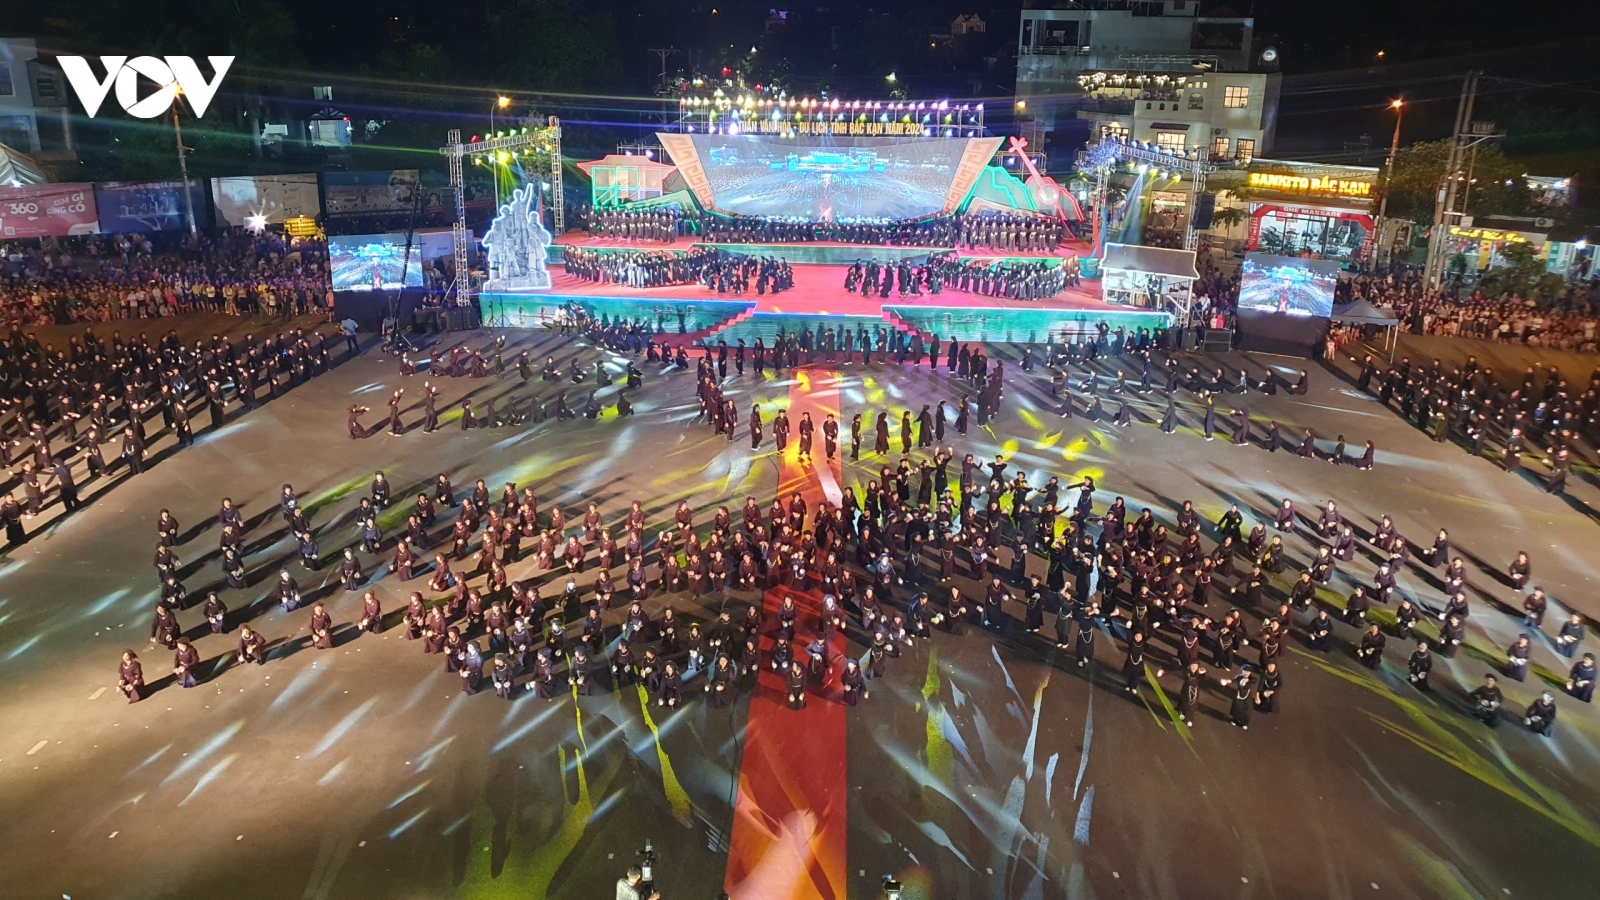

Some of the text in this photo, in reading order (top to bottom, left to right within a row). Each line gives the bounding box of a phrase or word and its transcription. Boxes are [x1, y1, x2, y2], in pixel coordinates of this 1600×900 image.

[800, 122, 809, 133] DU
[812, 122, 828, 135] LỊCH
[867, 123, 883, 136] KẠN
[905, 123, 925, 134] 2024
[1250, 173, 1309, 189] SANKITO
[68, 200, 86, 213] CÓ
[1301, 209, 1342, 218] MASSAGE
